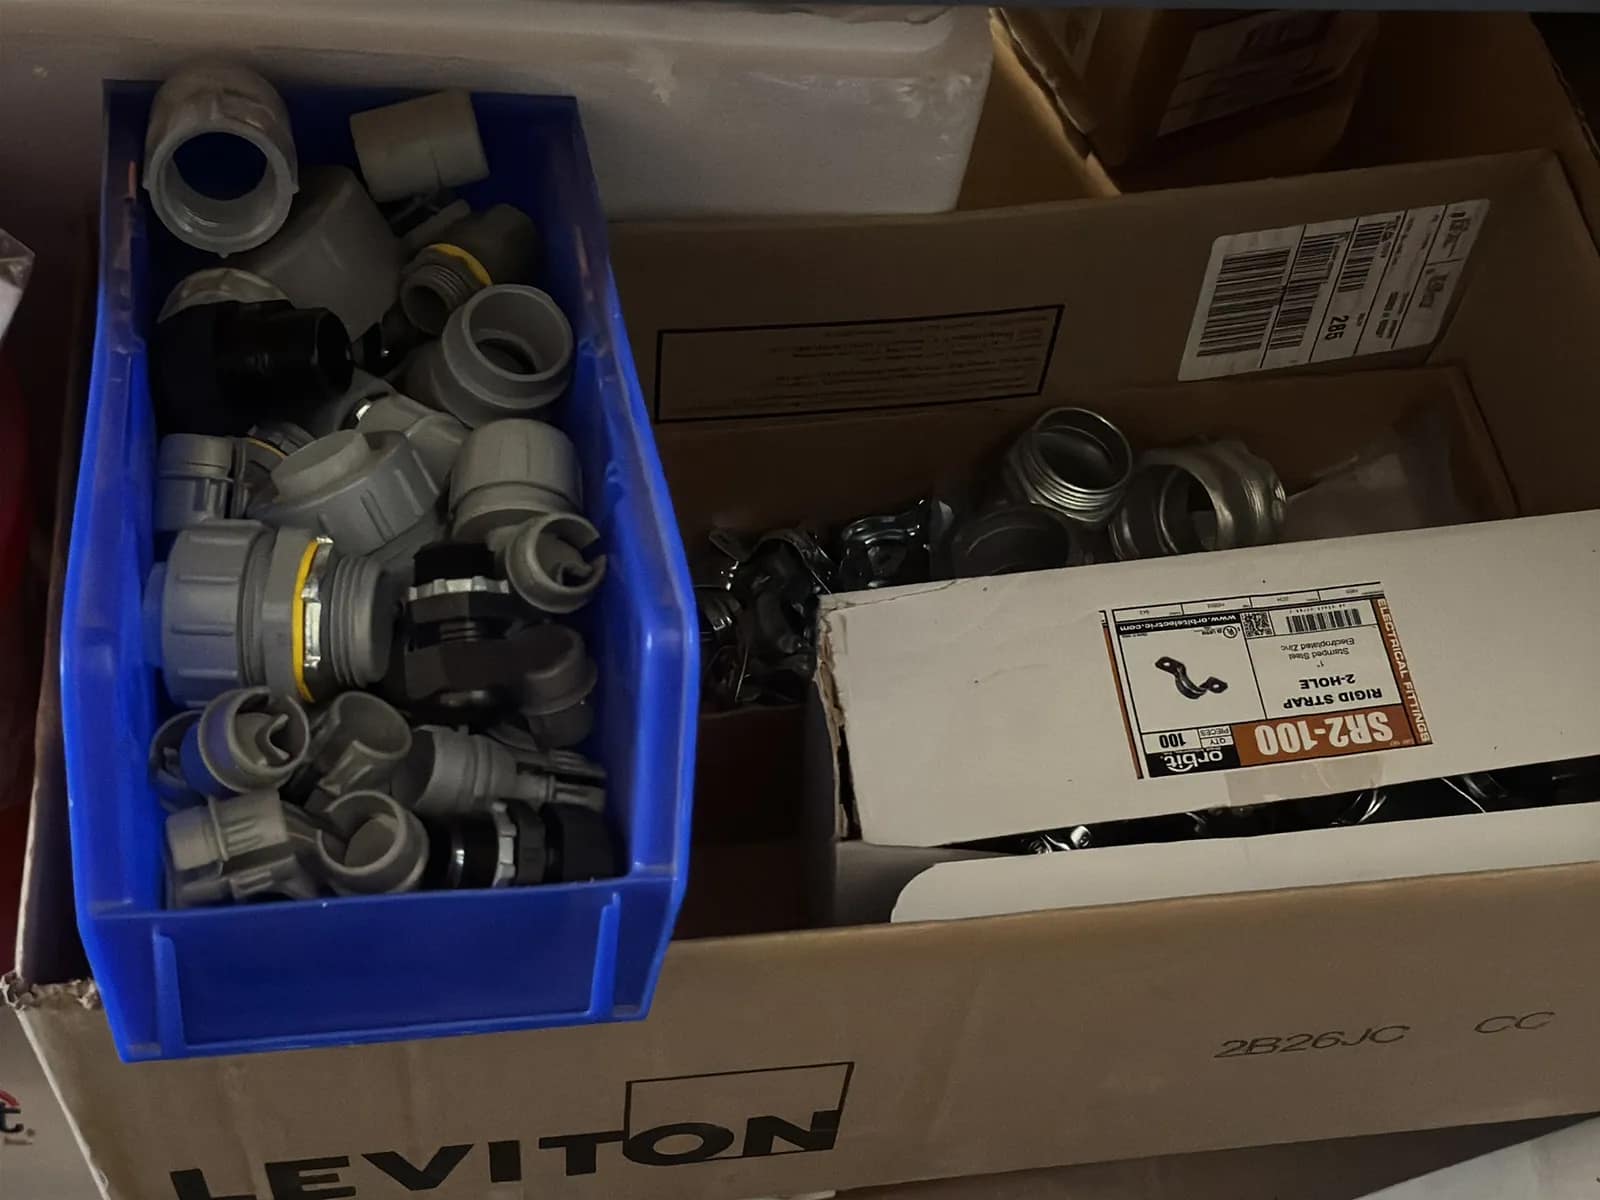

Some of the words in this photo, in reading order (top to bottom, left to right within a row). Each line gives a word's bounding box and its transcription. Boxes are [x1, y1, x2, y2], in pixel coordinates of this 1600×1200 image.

[1324, 315, 1349, 340] 285
[1119, 614, 1237, 632] www.orbitelectric.com
[1280, 643, 1299, 651] Zinc
[1301, 637, 1355, 651] Electroplated
[1288, 652, 1310, 660] Steel
[1312, 647, 1350, 660] Stamped
[1377, 598, 1409, 679] ELECTRICAL
[1403, 681, 1431, 742] FITTINGS
[1299, 673, 1356, 690] 2-HOLE
[1283, 694, 1334, 709] STRAP
[1338, 688, 1383, 703] RIGID
[1200, 726, 1230, 736] PIECES
[1254, 711, 1393, 756] SR2-100
[1159, 733, 1187, 748] 100
[1210, 737, 1226, 745] QTY
[1163, 750, 1223, 771] orbit
[1214, 1026, 1411, 1058] 2B26JC
[1474, 1011, 1556, 1034] CC
[170, 1109, 841, 1200] LEVITON
